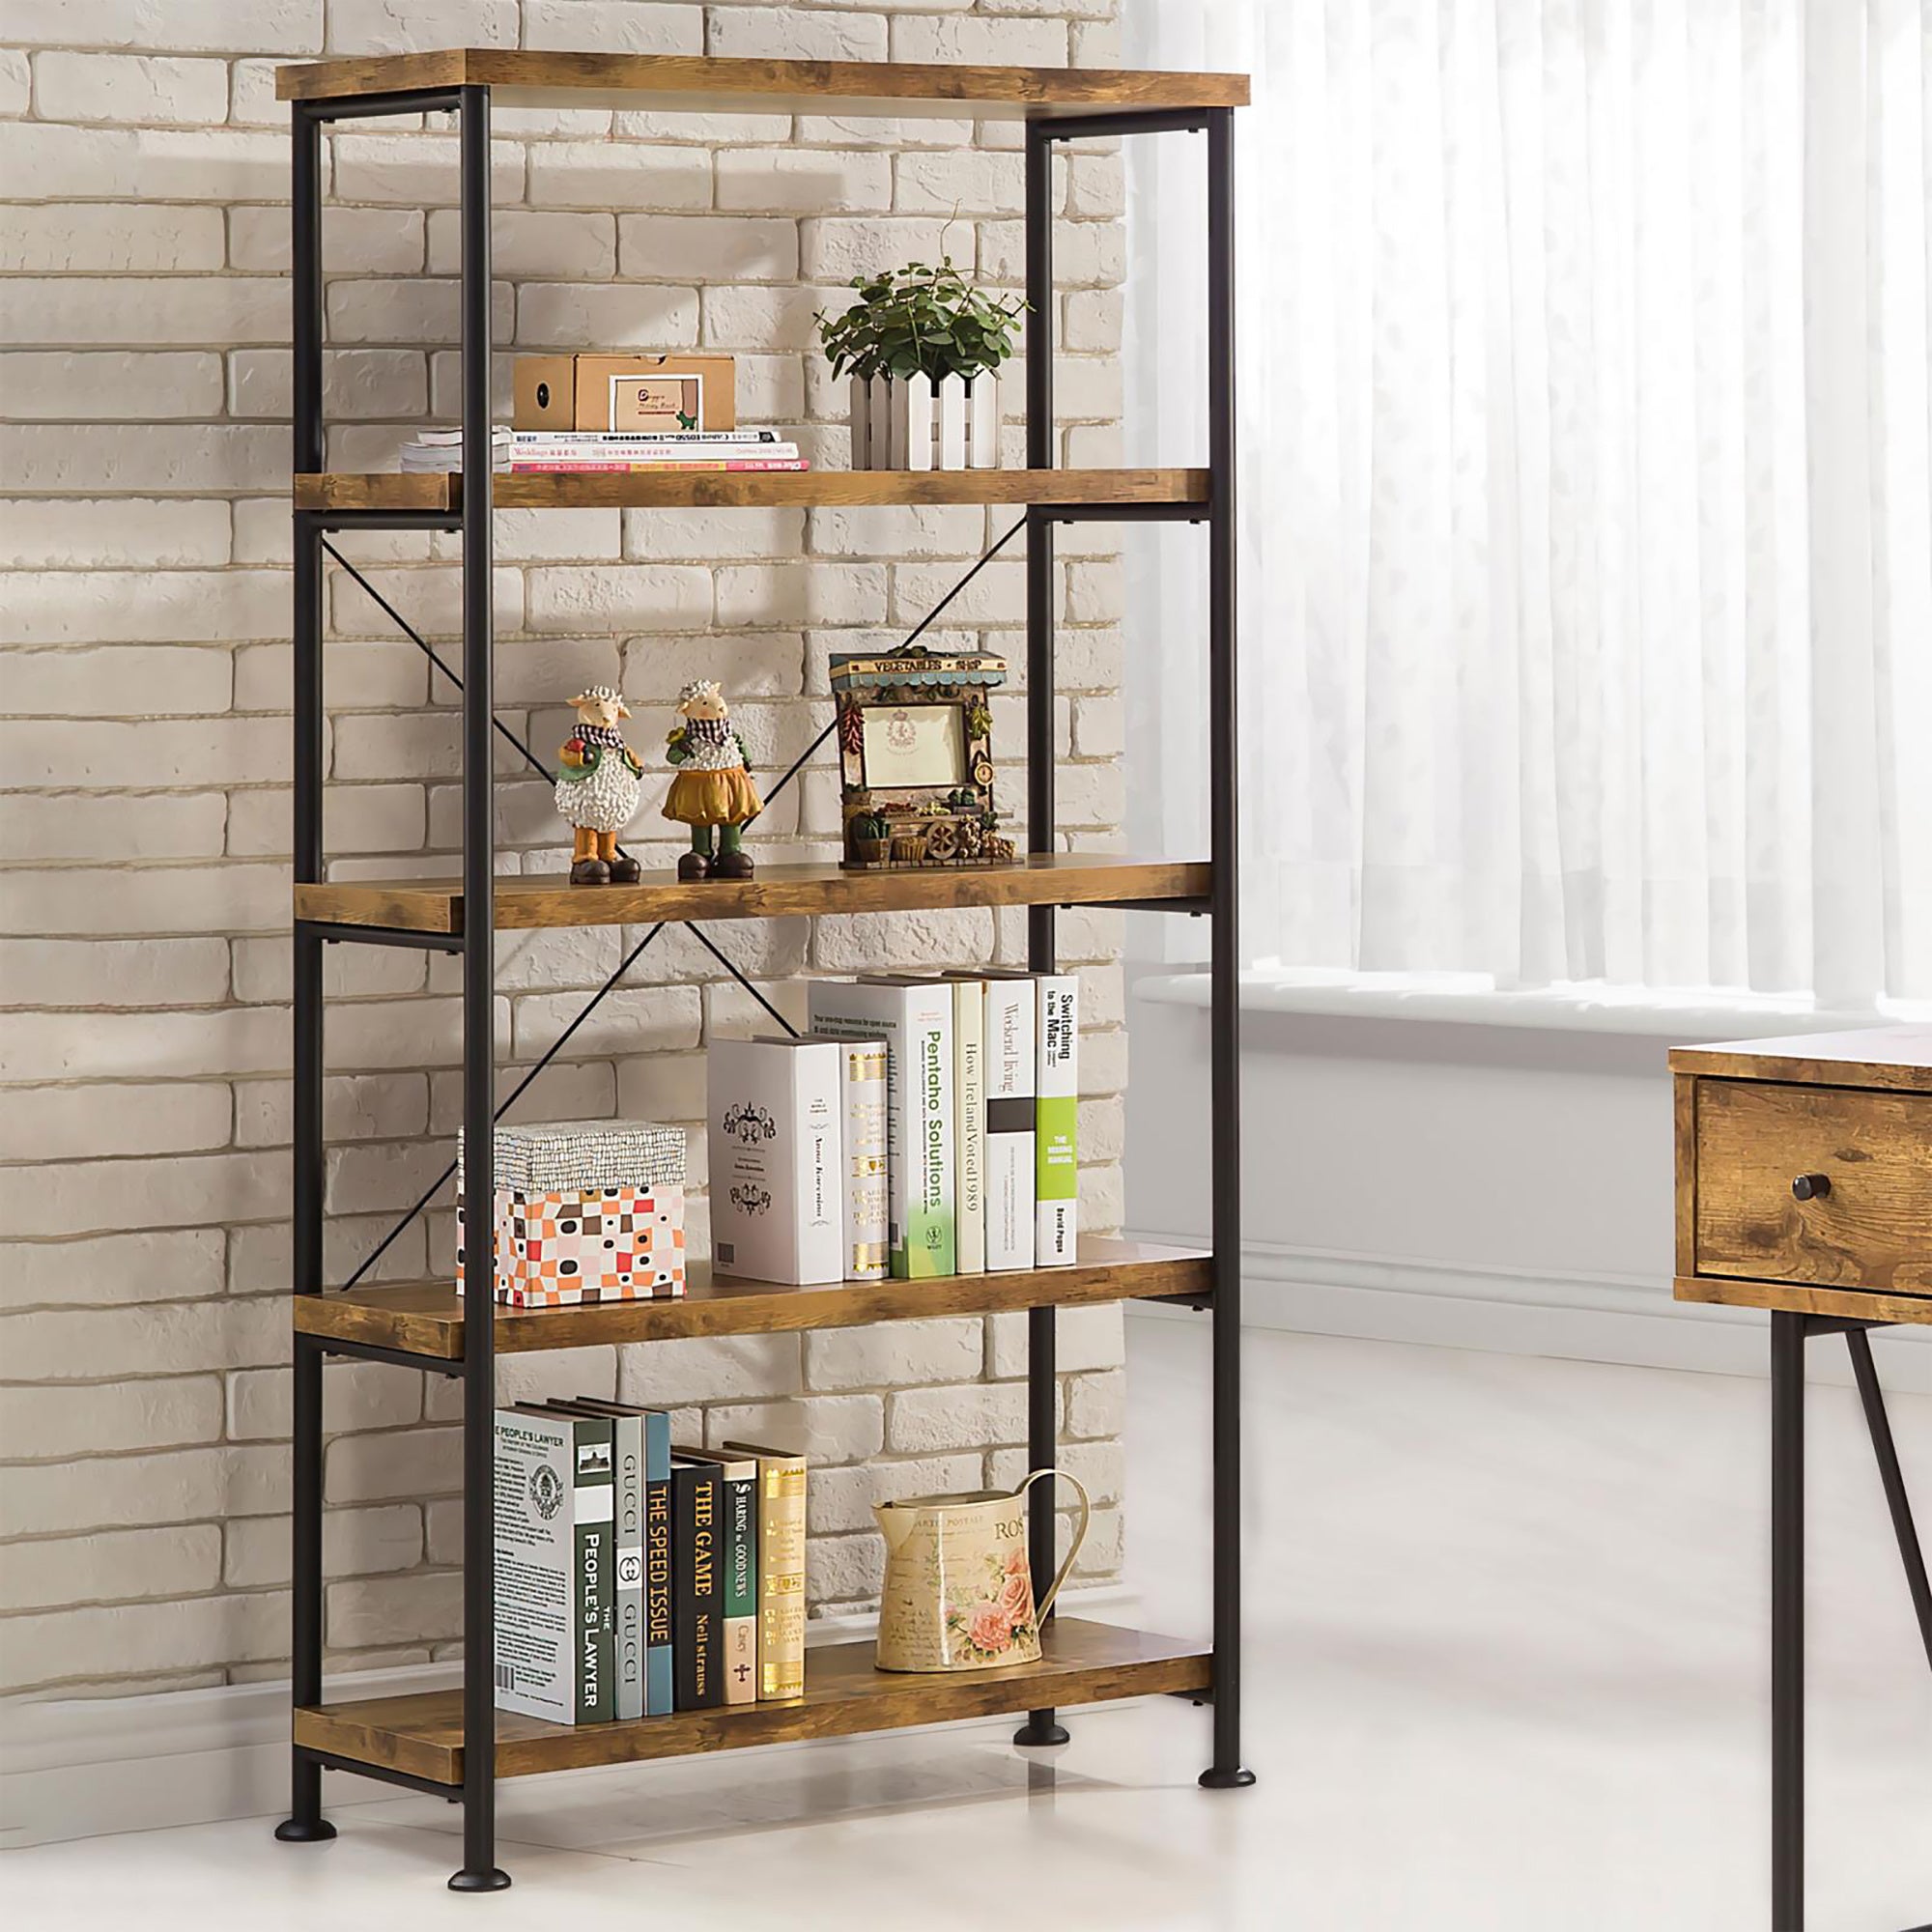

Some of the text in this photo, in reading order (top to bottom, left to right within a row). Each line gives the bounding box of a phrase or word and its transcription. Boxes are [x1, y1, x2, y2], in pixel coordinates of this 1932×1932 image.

[874, 659, 981, 672] VEGETABLES SHOP
[998, 1004, 1018, 1092] Weekend living
[1047, 990, 1060, 1048] to the Mac
[1057, 994, 1073, 1060] Switching
[927, 1031, 942, 1110] Pentaho
[965, 1043, 977, 1076] How
[928, 1120, 943, 1207] Solutions
[500, 1426, 533, 1441] PEOPLE'S
[534, 1434, 564, 1447] LAWYER
[623, 1455, 636, 1533] GUCCI
[696, 1481, 713, 1526] THE
[733, 1483, 752, 1532] SHARING
[649, 1486, 668, 1641] THE SPEED ISSUE
[696, 1531, 713, 1596] GAME
[584, 1533, 599, 1707] PEOPLE'S LAWYER
[624, 1605, 637, 1683] GUCCI
